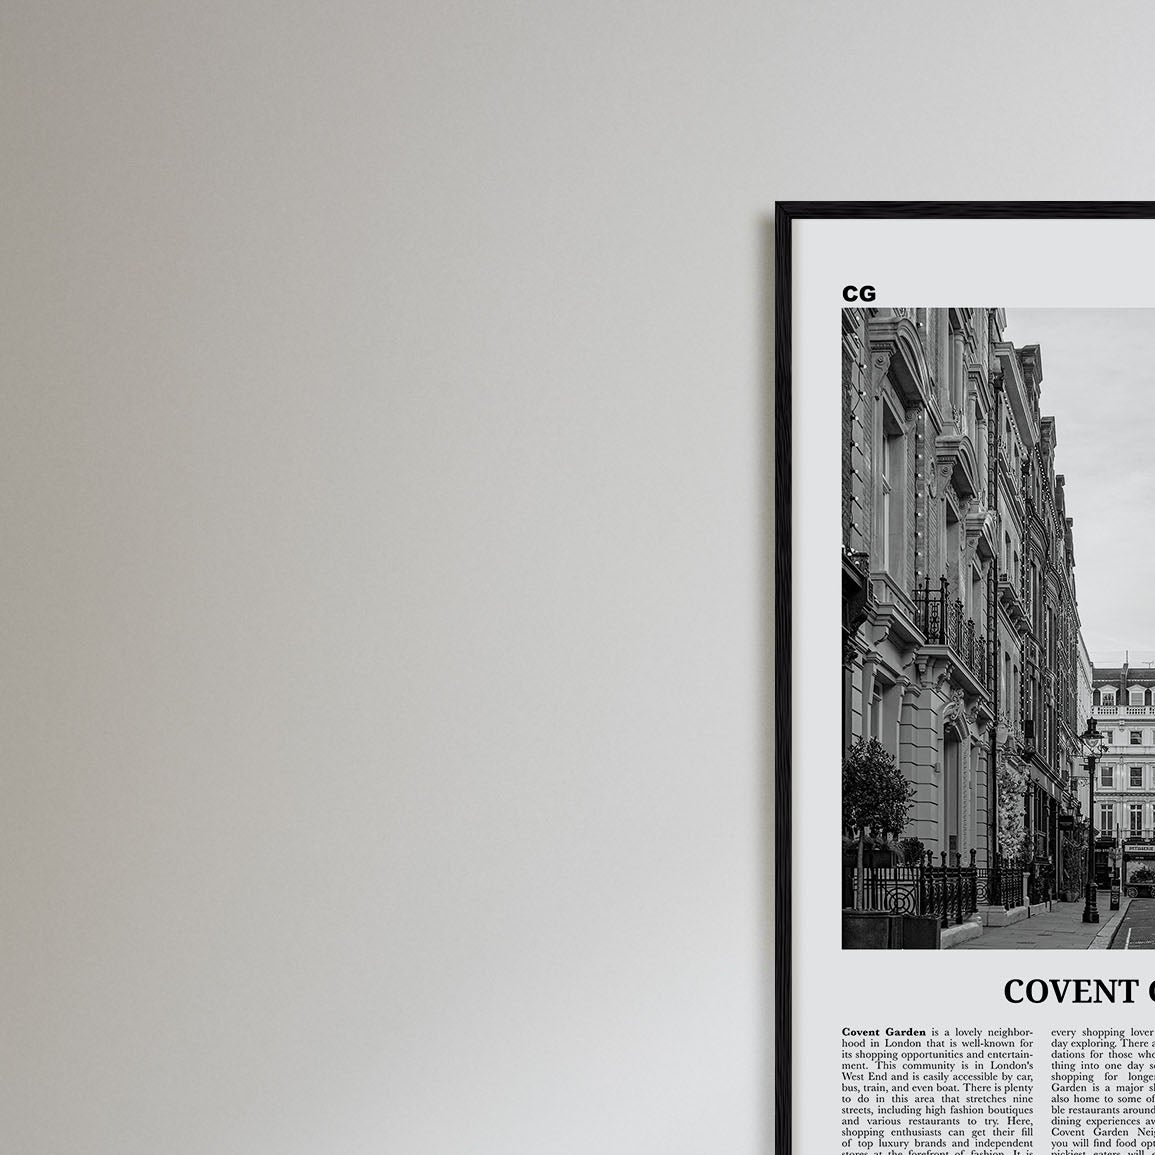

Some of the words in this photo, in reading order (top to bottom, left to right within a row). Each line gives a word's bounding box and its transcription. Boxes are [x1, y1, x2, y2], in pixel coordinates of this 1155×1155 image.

[842, 285, 877, 303] CG
[1004, 979, 1139, 1003] COVENT
[842, 1028, 880, 1036] Covent
[885, 1028, 926, 1036] Garden
[932, 1028, 939, 1036] is
[955, 1028, 982, 1038] lovely
[988, 1028, 1033, 1038] neighbor-
[1051, 1030, 1076, 1038] every
[1082, 1028, 1125, 1038] shopping
[1131, 1028, 1154, 1036] lover
[1051, 1039, 1067, 1050] day
[1071, 1039, 1117, 1050] exploring.
[1120, 1039, 1149, 1047] There
[842, 1050, 852, 1058] its
[855, 1050, 898, 1061] shopping
[901, 1050, 963, 1061] opportunities
[966, 1050, 984, 1058] and
[987, 1050, 1033, 1058] entertain-
[1051, 1050, 1085, 1058] dations
[1090, 1050, 1104, 1058] for
[1108, 1050, 1133, 1058] those
[842, 1072, 864, 1080] West
[868, 1072, 887, 1080] End
[891, 1072, 909, 1080] and
[912, 1072, 920, 1080] is
[923, 1072, 949, 1083] easily
[953, 1072, 998, 1080] accessible
[1002, 1072, 1013, 1083] by
[1016, 1074, 1033, 1082] car,
[1051, 1072, 1094, 1083] shopping
[1104, 1072, 1118, 1080] for
[857, 1094, 870, 1102] do
[876, 1094, 885, 1102] in
[892, 1094, 908, 1102] this
[941, 1094, 960, 1102] that
[966, 1094, 1007, 1102] stretches
[1013, 1094, 1033, 1102] nine
[1051, 1094, 1070, 1102] also
[1074, 1094, 1100, 1102] home
[1146, 1094, 1155, 1102] of
[841, 1116, 859, 1125] and
[867, 1116, 901, 1125] various
[908, 1117, 960, 1125] restaurants
[967, 1117, 977, 1125] to
[985, 1117, 999, 1127] try.
[1007, 1116, 1033, 1126] Here,
[1051, 1116, 1081, 1127] dining
[1086, 1116, 1140, 1127] experiences
[841, 1139, 851, 1147] of
[858, 1140, 874, 1150] top
[879, 1139, 909, 1150] luxury
[915, 1139, 947, 1147] brands
[952, 1139, 969, 1147] and
[975, 1139, 1033, 1150] independent
[1051, 1141, 1068, 1150] you
[1072, 1139, 1089, 1147] will
[1093, 1139, 1111, 1147] find
[1116, 1139, 1137, 1147] food
